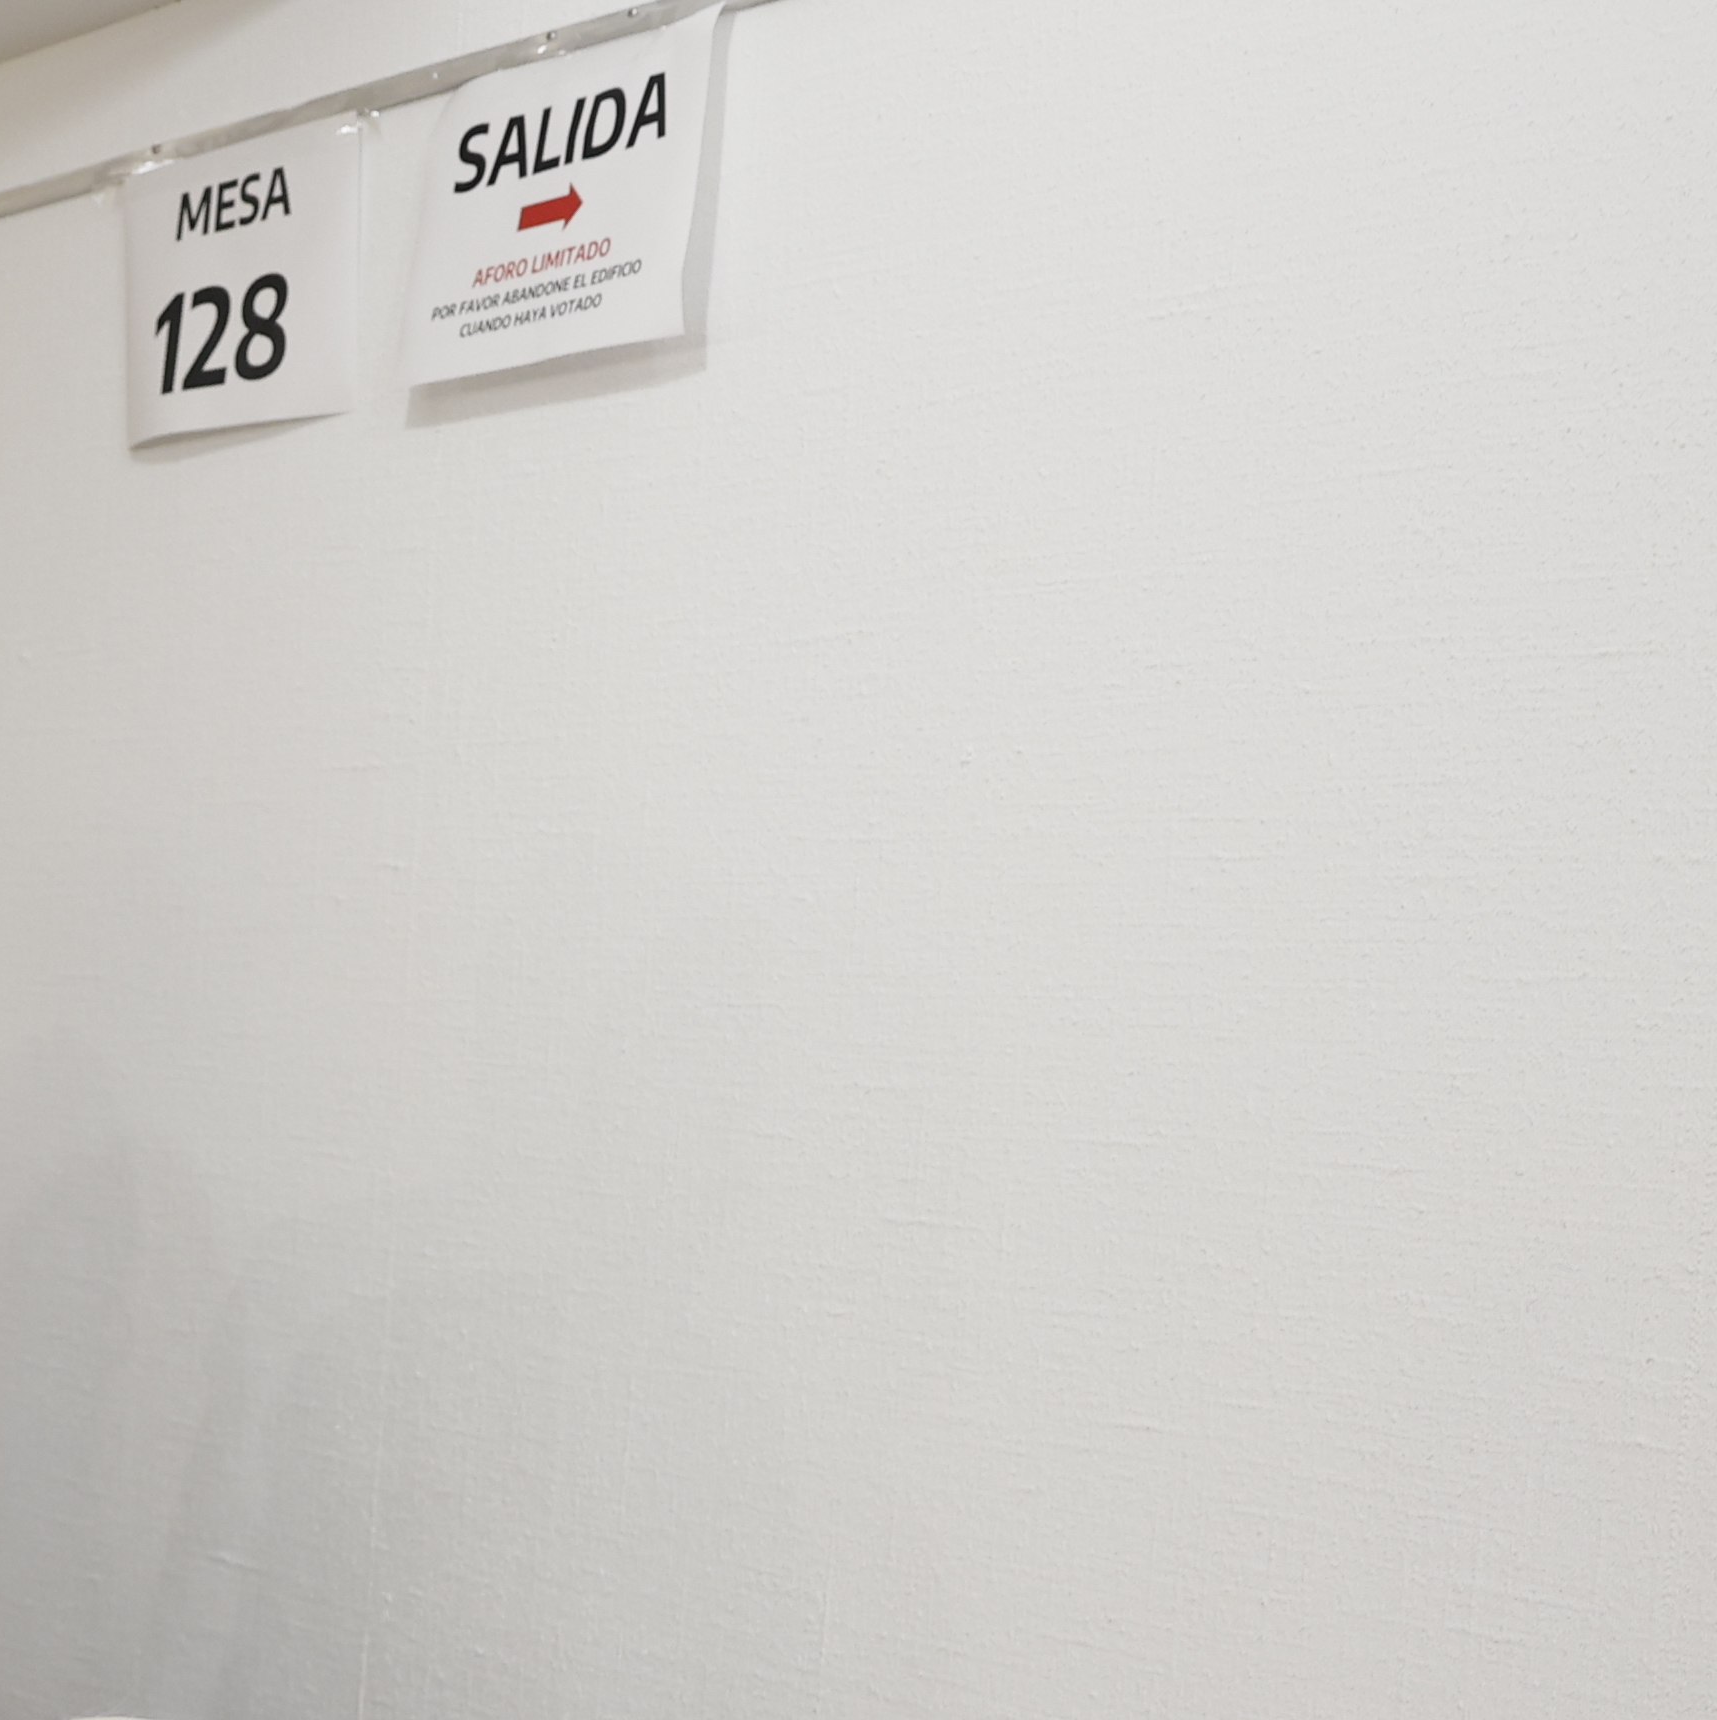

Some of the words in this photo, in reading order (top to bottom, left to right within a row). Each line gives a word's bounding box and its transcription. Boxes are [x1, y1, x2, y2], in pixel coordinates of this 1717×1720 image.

[452, 71, 667, 194] SALIDA
[175, 166, 292, 242] MESA
[431, 302, 457, 322] POR
[459, 291, 501, 315] FAVOR
[501, 275, 572, 309] ABANDONE
[572, 273, 589, 292] EL
[590, 257, 643, 289] EDIFICIO
[472, 255, 529, 289] AFORO
[531, 236, 613, 280] LIMITADO
[153, 272, 289, 395] 128
[459, 311, 513, 338] CUANDO
[514, 304, 549, 329] HAYA
[548, 293, 604, 322] VOTADO
